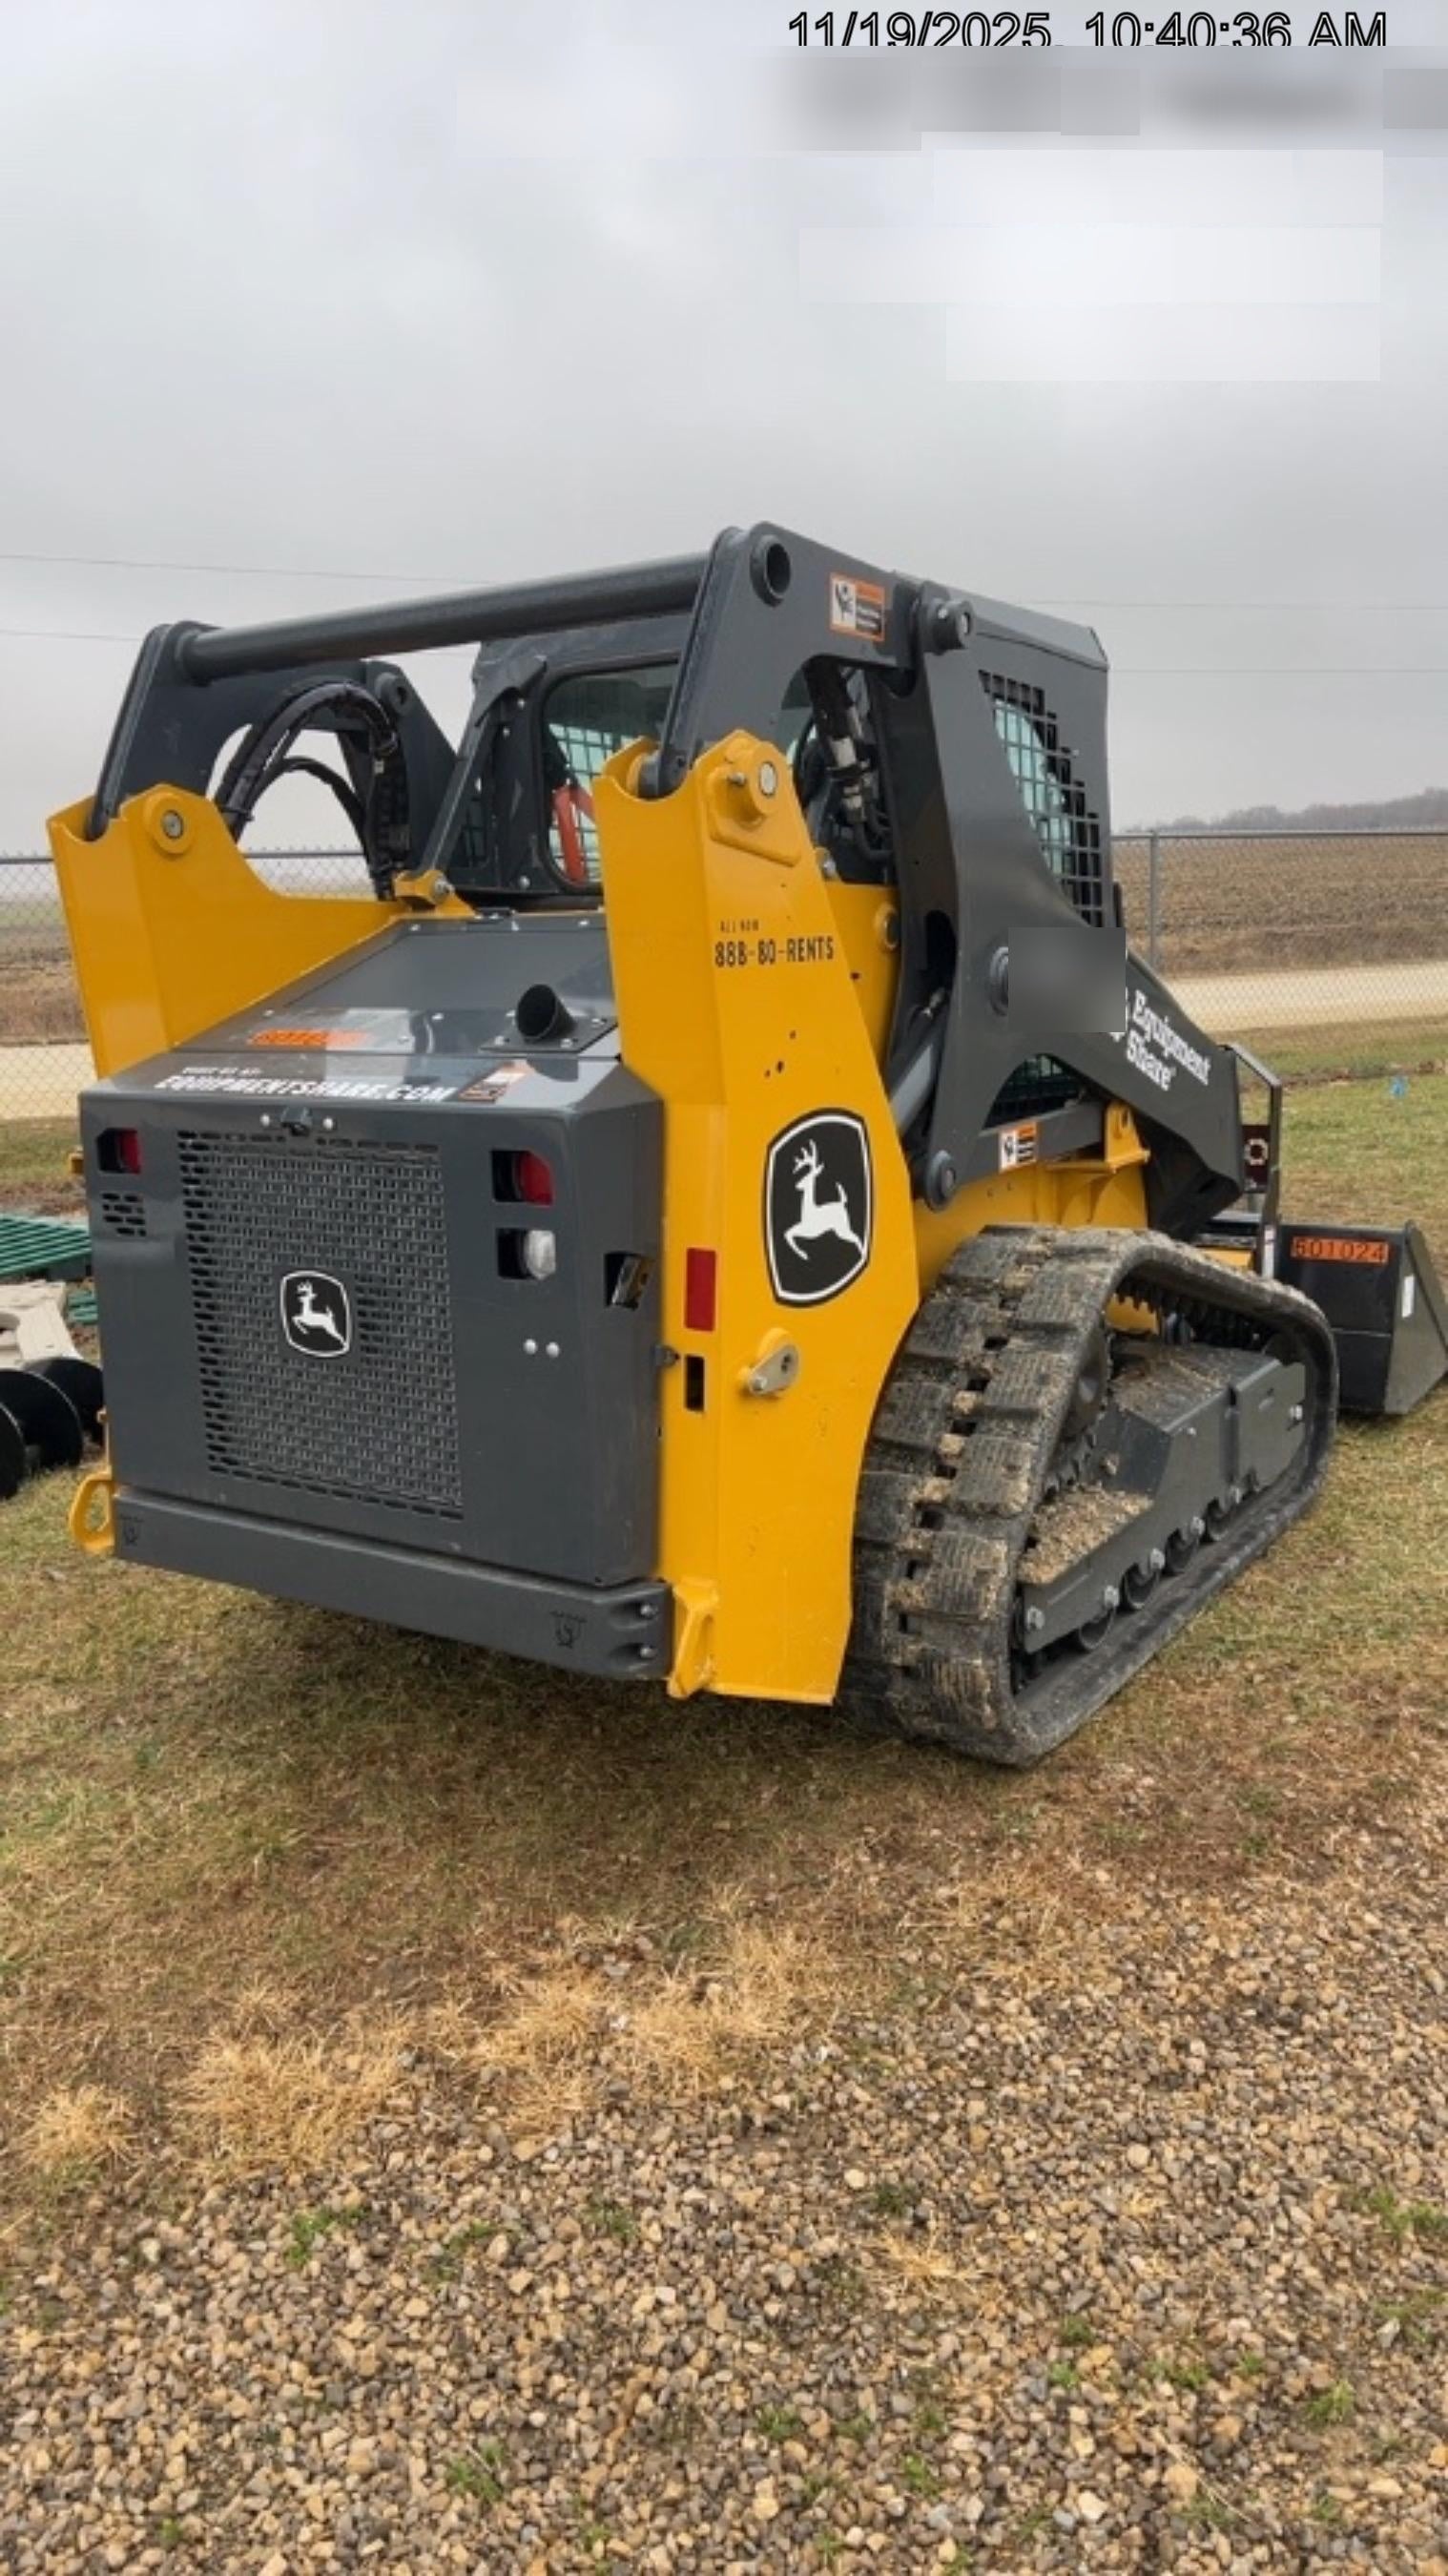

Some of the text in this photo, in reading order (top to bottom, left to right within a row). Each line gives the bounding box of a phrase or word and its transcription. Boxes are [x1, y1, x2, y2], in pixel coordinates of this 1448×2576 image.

[715, 937, 833, 967] 888-80-RENTS
[1127, 1028, 1170, 1091] Share
[1132, 988, 1211, 1086] Equipment
